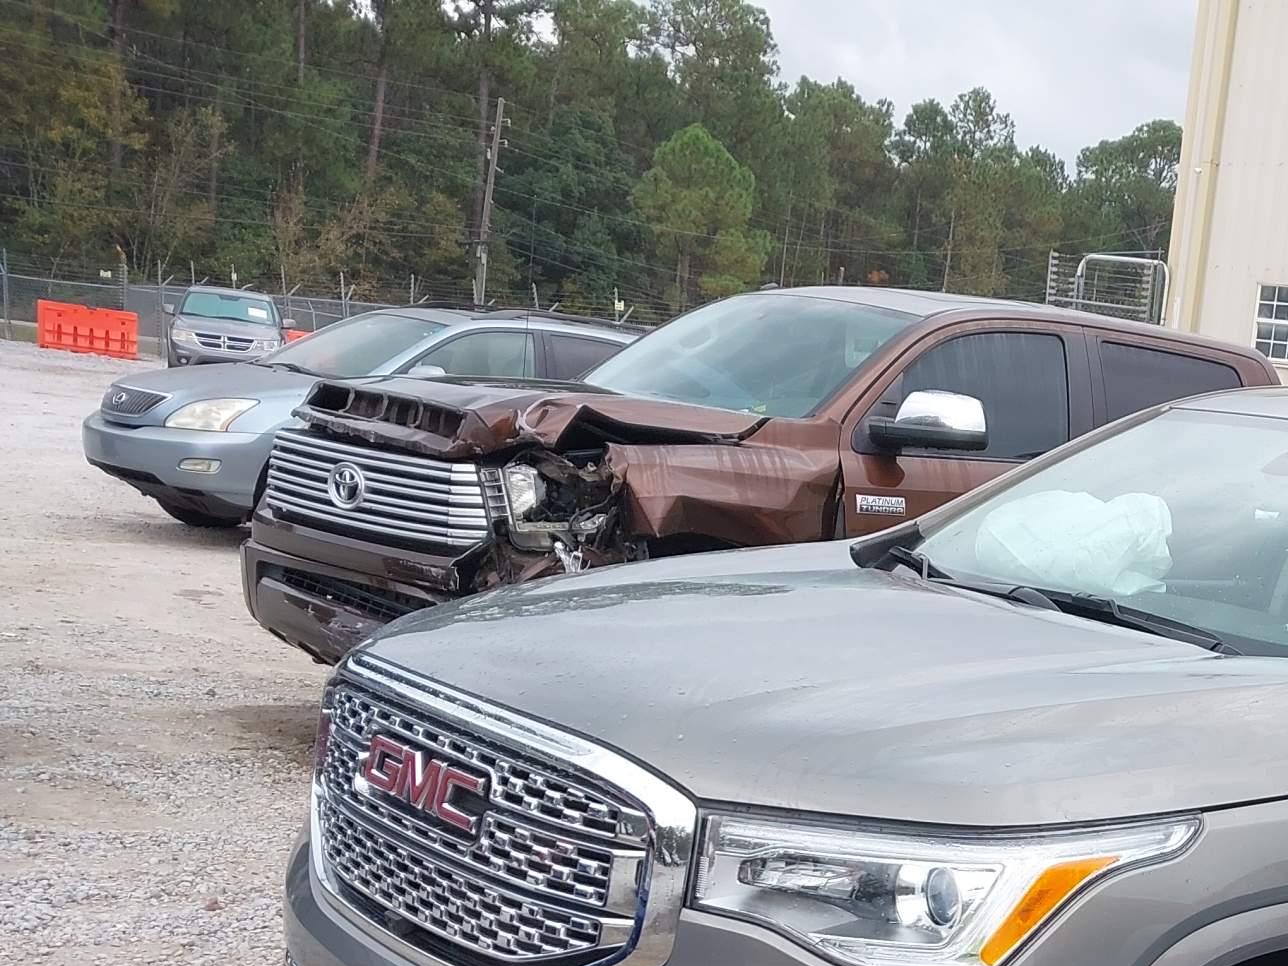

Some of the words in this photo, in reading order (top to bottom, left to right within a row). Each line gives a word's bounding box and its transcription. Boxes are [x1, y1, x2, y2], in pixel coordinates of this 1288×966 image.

[859, 496, 904, 506] PLATINUM
[860, 505, 905, 515] TUNDRA
[364, 734, 487, 835] GMC
